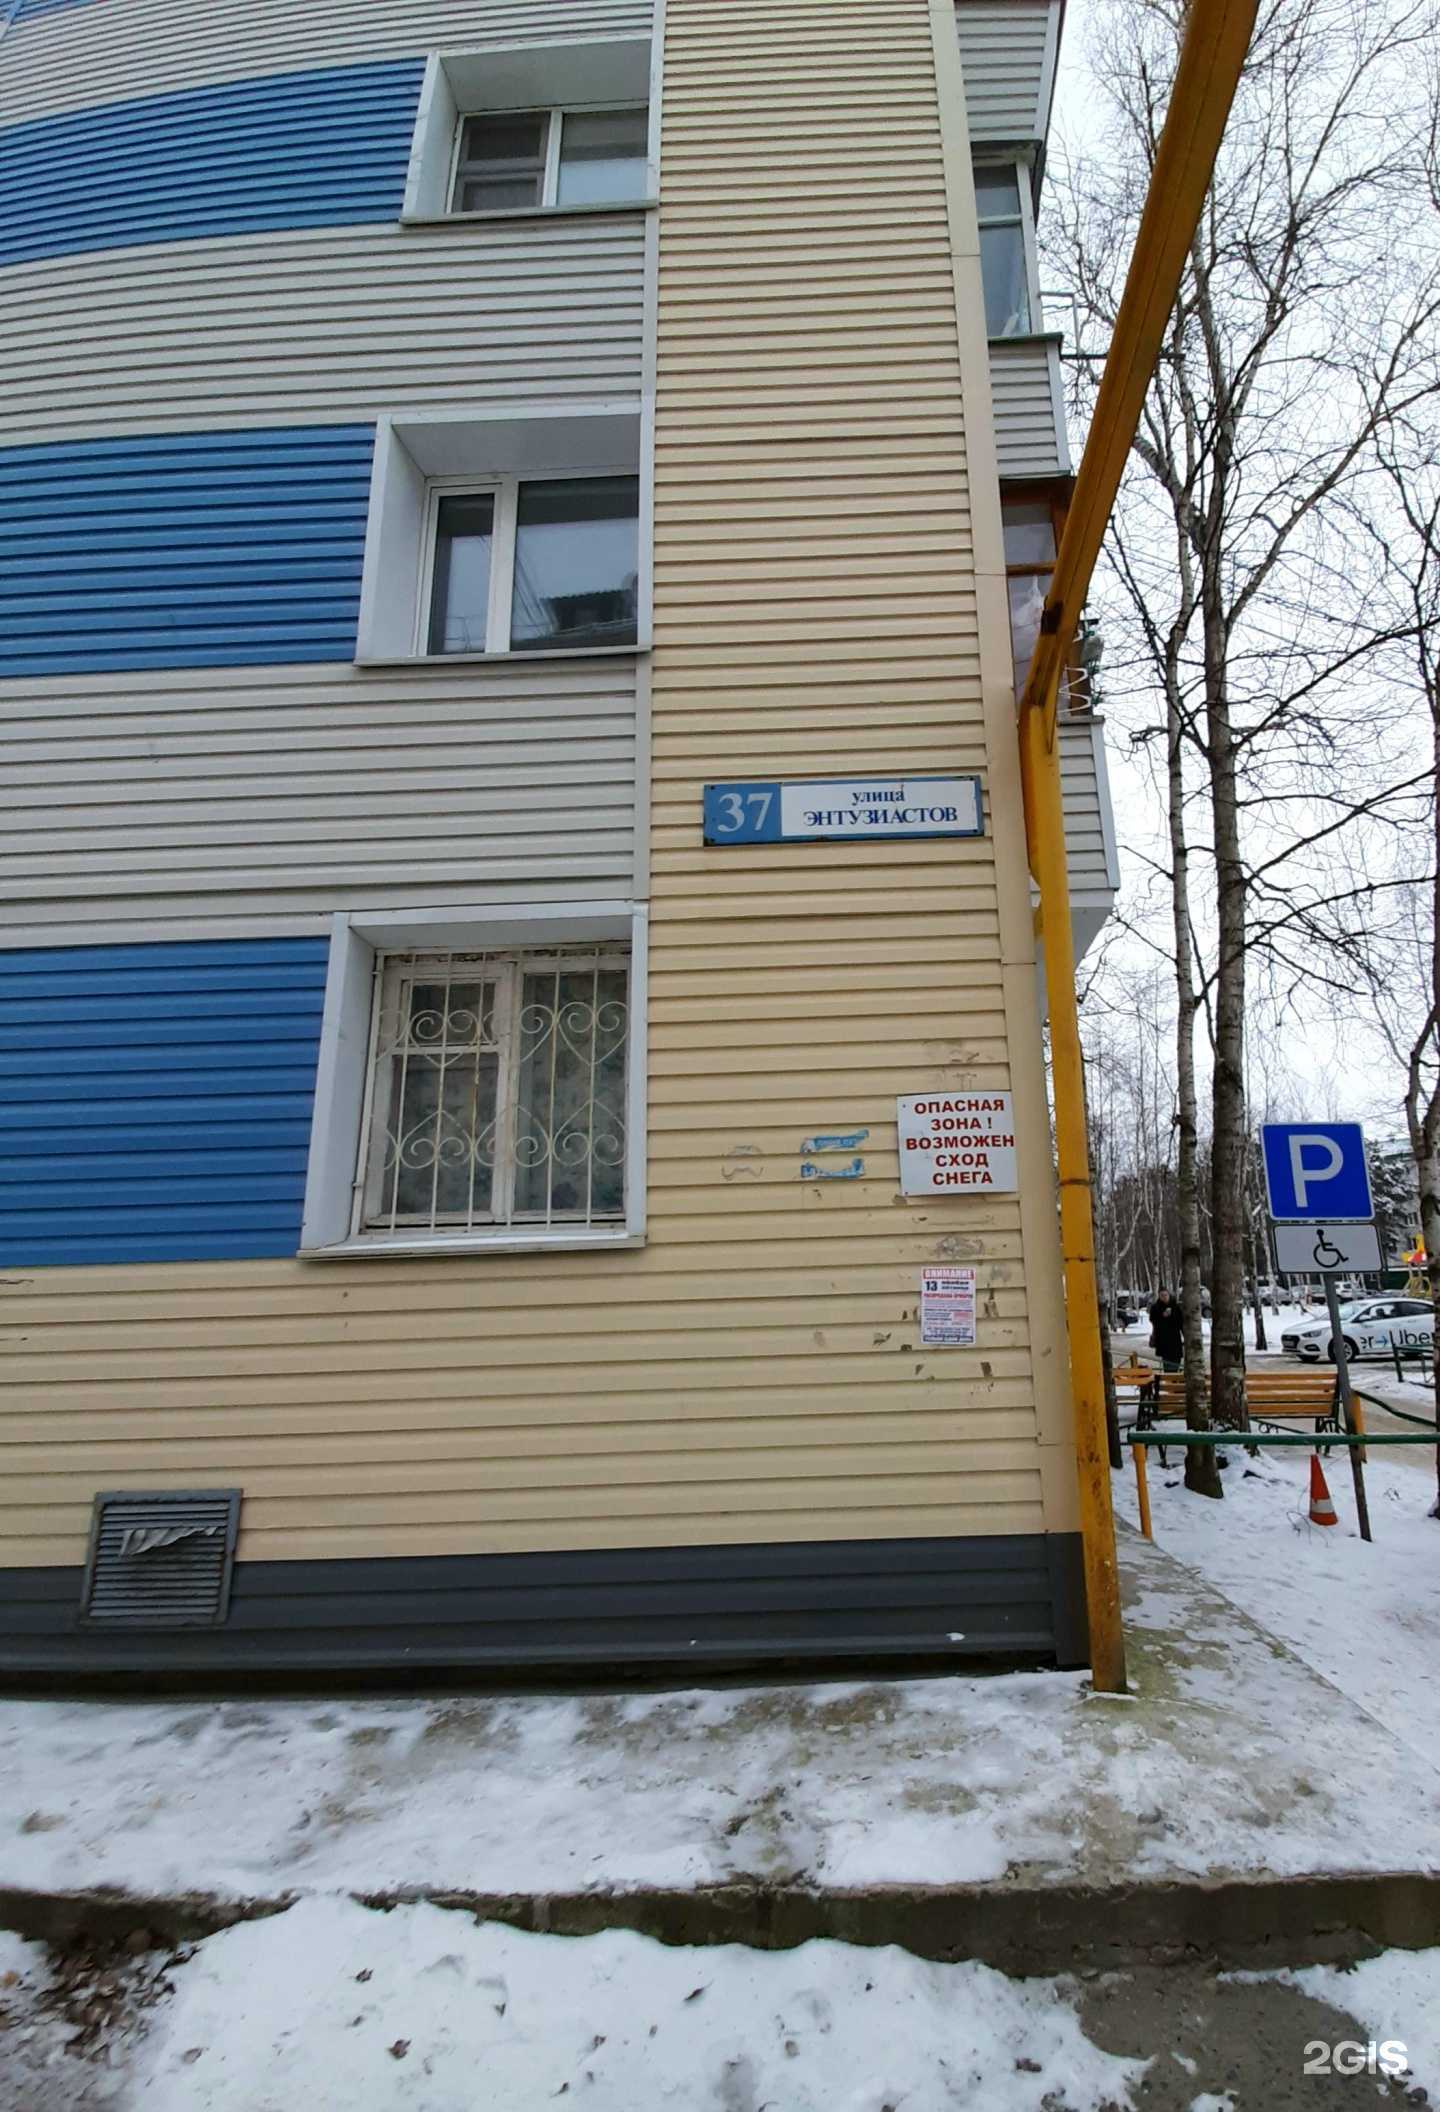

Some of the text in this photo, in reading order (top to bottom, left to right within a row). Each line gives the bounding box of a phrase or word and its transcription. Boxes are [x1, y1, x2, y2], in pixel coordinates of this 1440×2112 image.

[851, 789, 905, 806] улица
[717, 792, 774, 833] 37
[803, 806, 958, 827] ЭНТУЗИАСТОВ
[914, 1099, 1005, 1114] ОПАСНАЯ
[905, 1134, 1015, 1150] ВОЗМОЖЕН
[935, 1153, 989, 1168] СХОД
[932, 1171, 993, 1185] СНЕГА
[926, 1280, 938, 1291] 13
